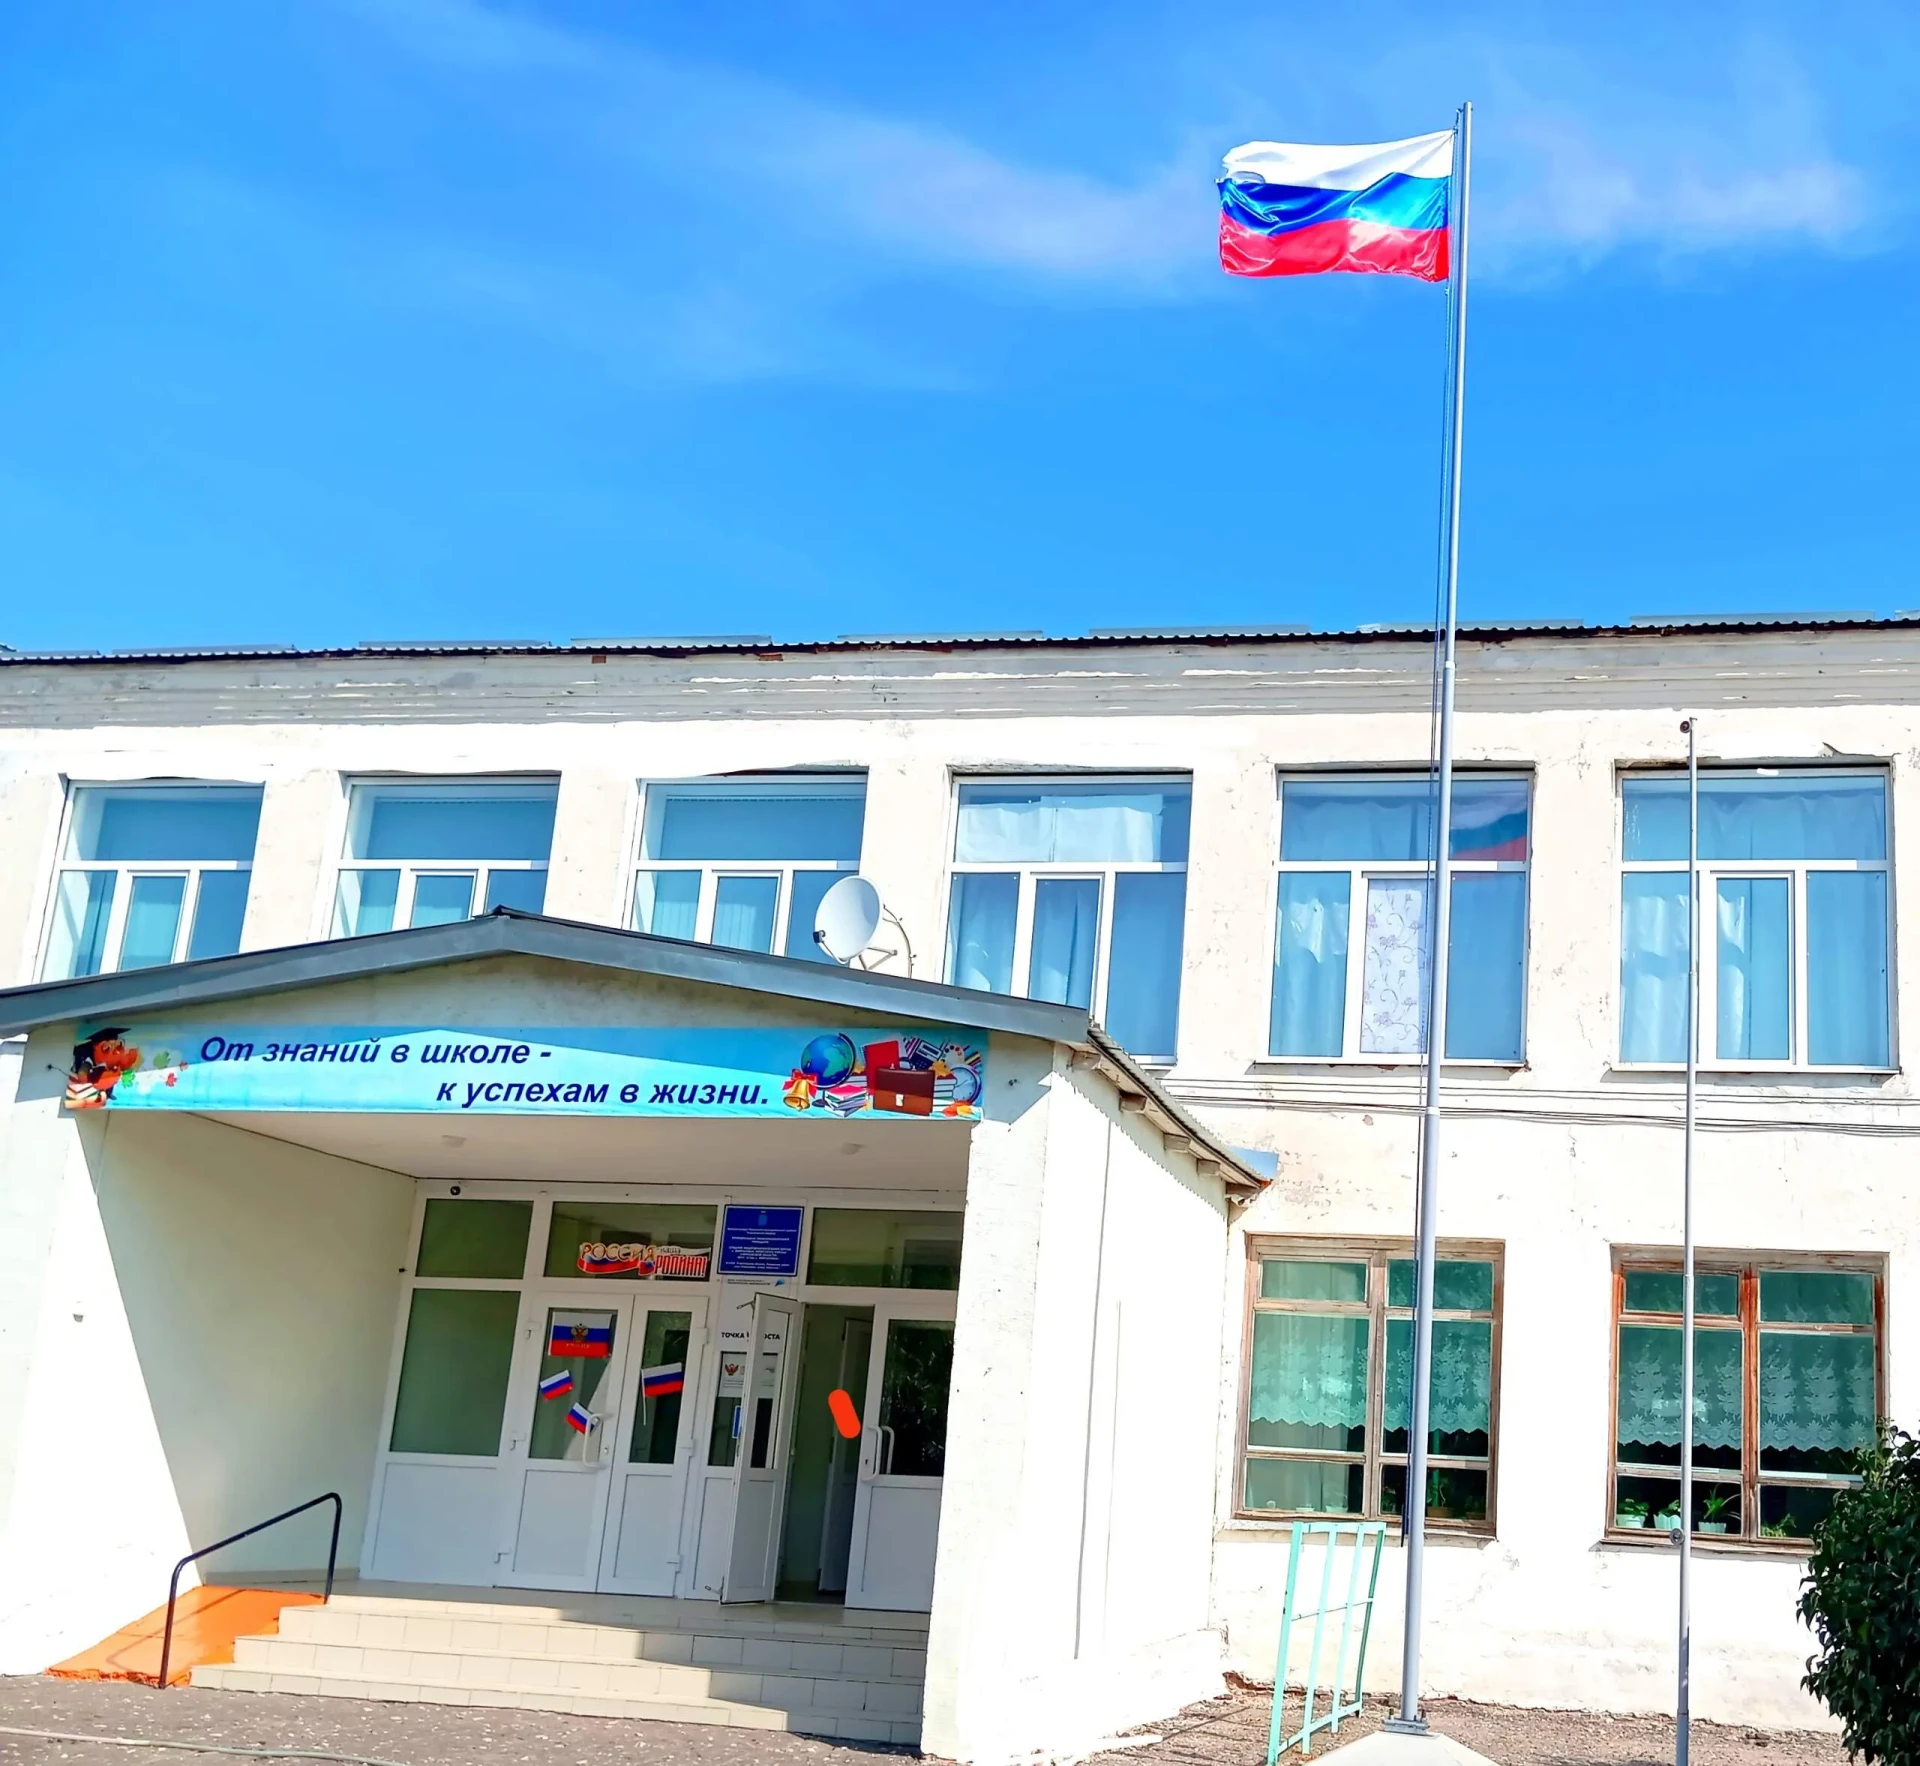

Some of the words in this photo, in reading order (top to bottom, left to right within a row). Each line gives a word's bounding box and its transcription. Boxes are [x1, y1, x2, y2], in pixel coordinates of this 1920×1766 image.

[200, 1036, 254, 1061] От
[262, 1037, 381, 1063] знаний
[390, 1044, 410, 1063] в
[420, 1043, 530, 1064] школе
[436, 1082, 457, 1101] к
[461, 1082, 609, 1108] успехам
[620, 1083, 639, 1103] в
[648, 1084, 769, 1104] жизни.
[581, 1244, 656, 1262] РОССИЯ
[654, 1255, 708, 1275] РОДИНА!
